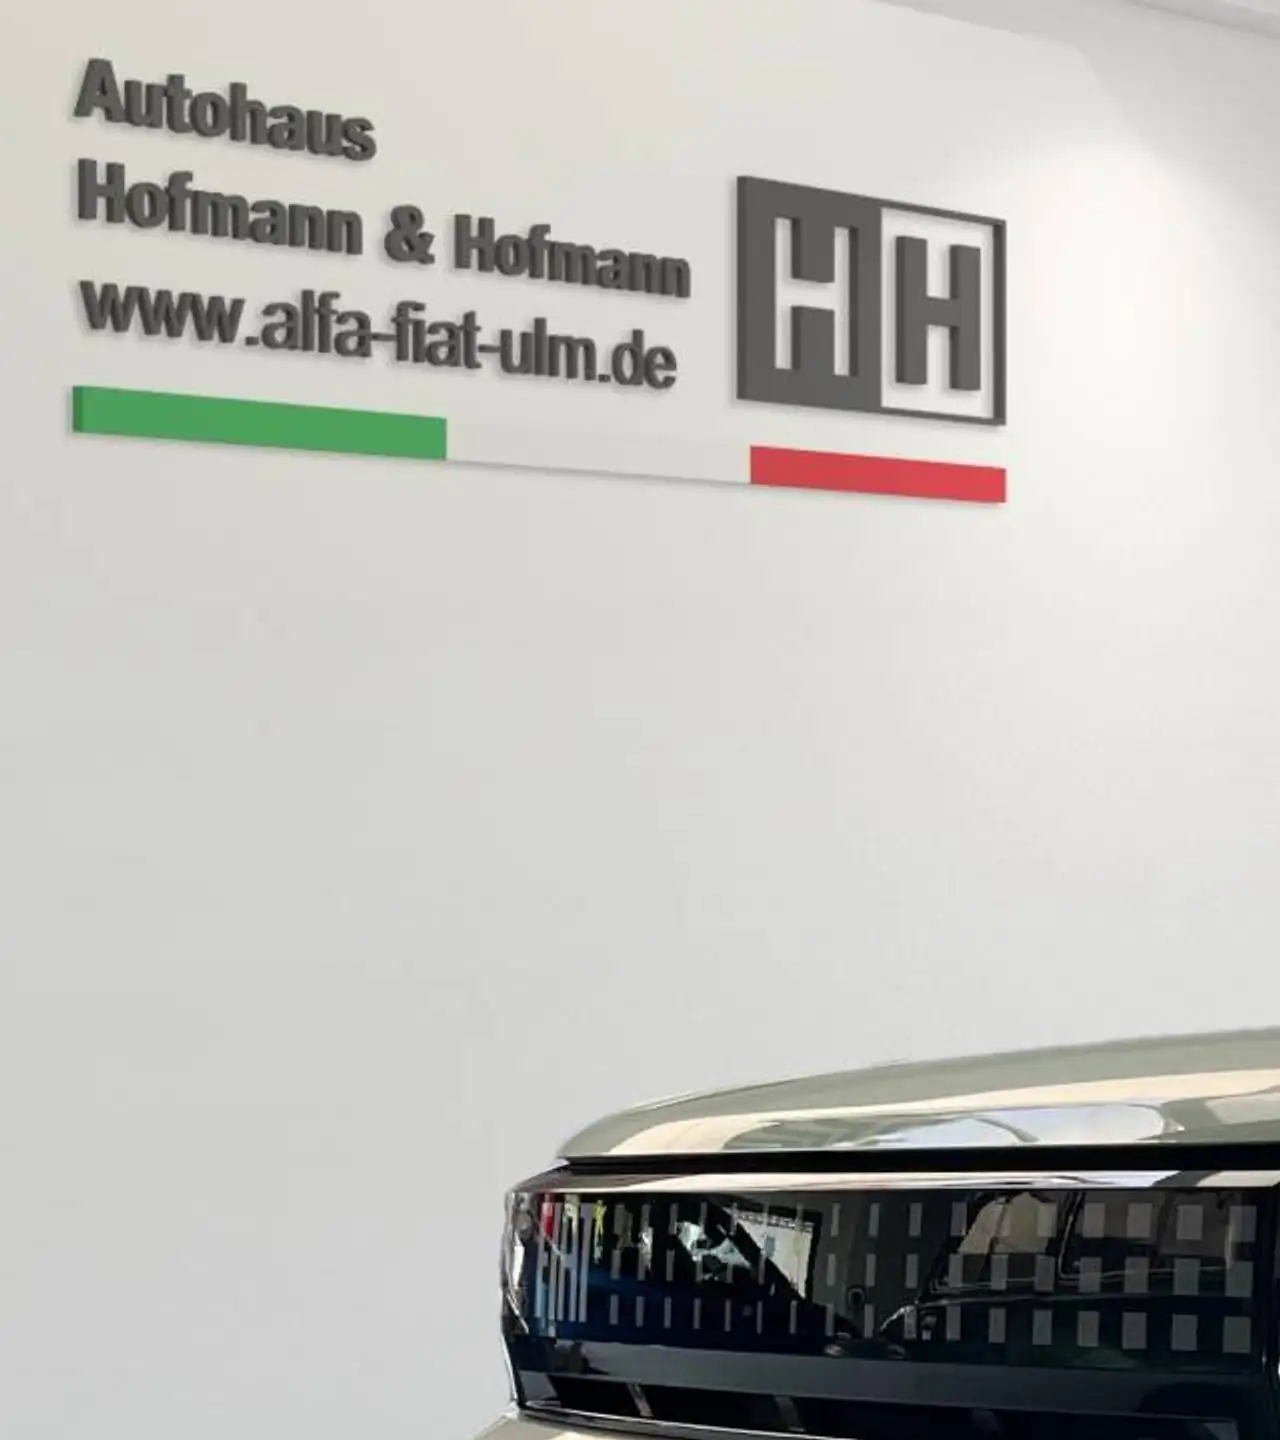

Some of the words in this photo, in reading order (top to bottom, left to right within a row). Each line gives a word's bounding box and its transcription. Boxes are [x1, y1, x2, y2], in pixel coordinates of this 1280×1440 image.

[73, 57, 377, 163] Autohaus
[76, 158, 363, 256] Hofmann
[383, 204, 436, 266] &
[453, 213, 692, 299] Hofmann
[78, 279, 678, 390] www.alfa-fiat-ulm.de
